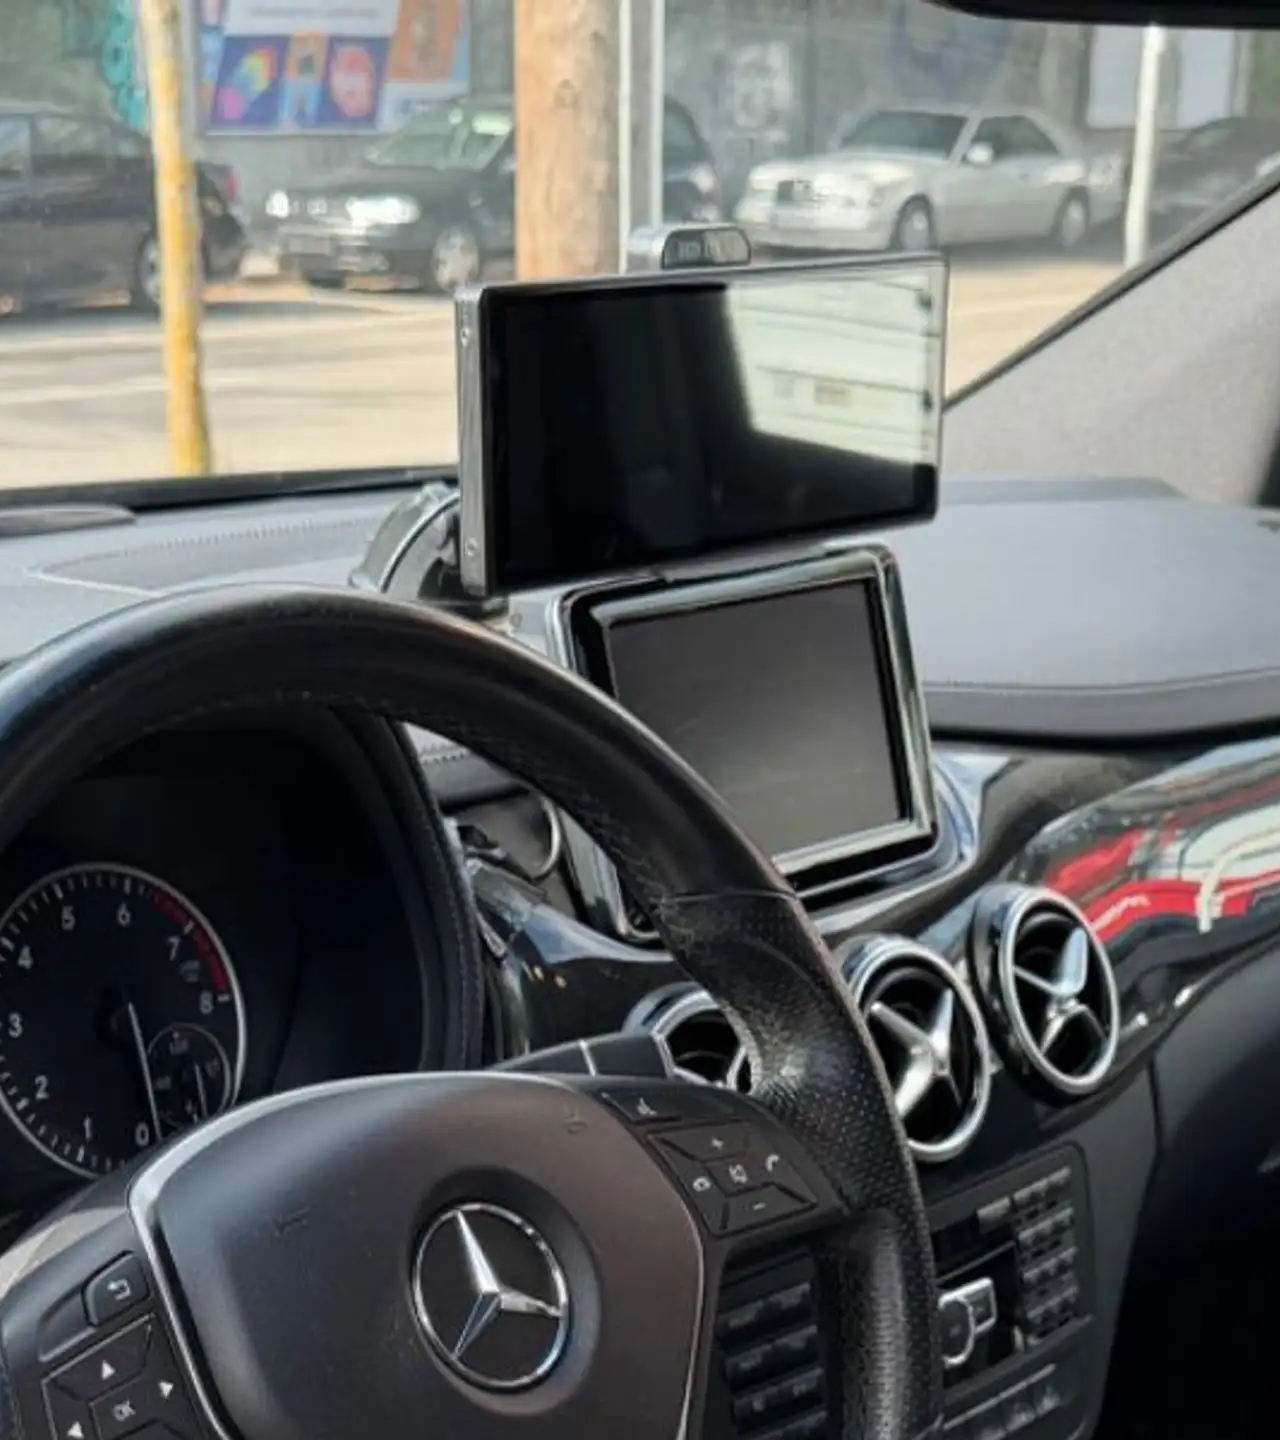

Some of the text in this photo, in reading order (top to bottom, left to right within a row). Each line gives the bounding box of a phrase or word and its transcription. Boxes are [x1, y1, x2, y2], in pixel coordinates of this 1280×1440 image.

[61, 906, 75, 931] 5
[117, 904, 131, 927] 6
[18, 945, 34, 970] 4
[166, 935, 181, 961] 7
[8, 1012, 23, 1038] 3
[34, 1075, 49, 1101] 2
[135, 1122, 150, 1146] 0
